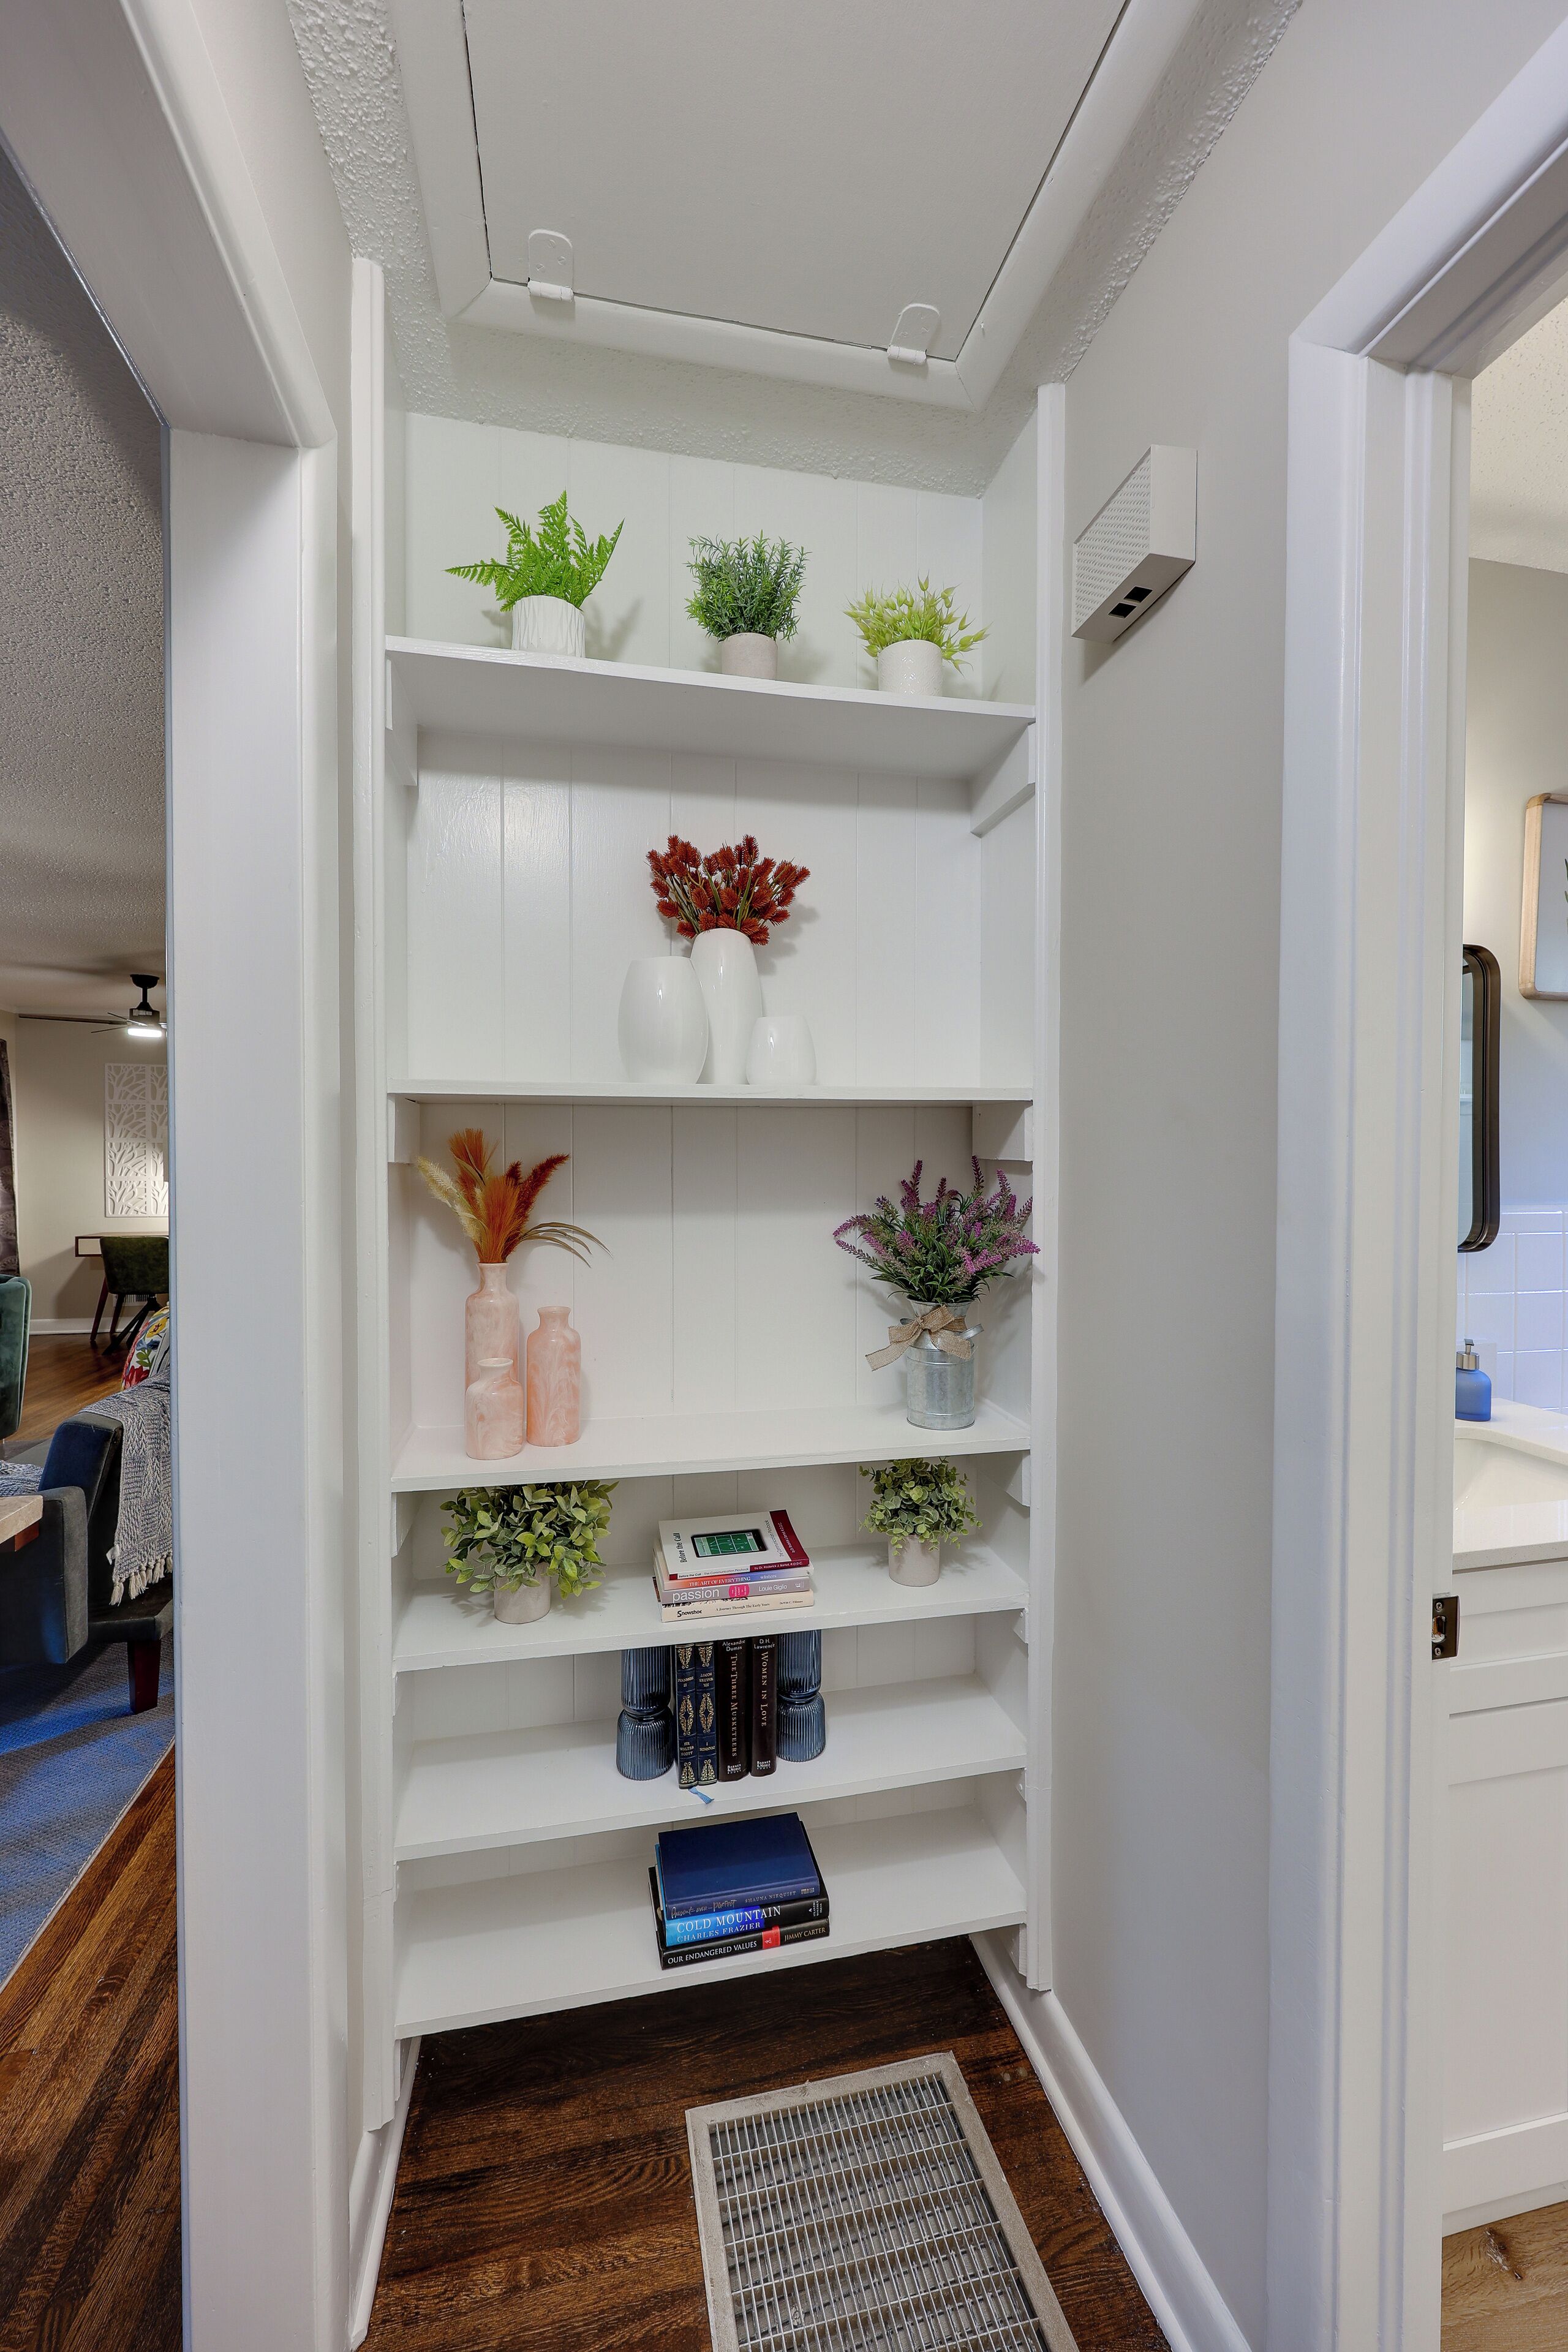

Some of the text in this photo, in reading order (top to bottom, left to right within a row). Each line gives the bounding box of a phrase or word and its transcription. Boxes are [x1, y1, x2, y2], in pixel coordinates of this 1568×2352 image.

[673, 1532, 682, 1542] Call
[673, 1588, 720, 1604] passion
[761, 1690, 767, 1699] IN
[677, 1905, 781, 1933] COLD MOUNTAIN
[677, 1922, 761, 1943] CHARLES FRAZIER
[784, 1927, 826, 1942] JIMMY CARTER
[685, 1946, 732, 1961] ENDANGERED
[734, 1940, 757, 1951] VALUES
